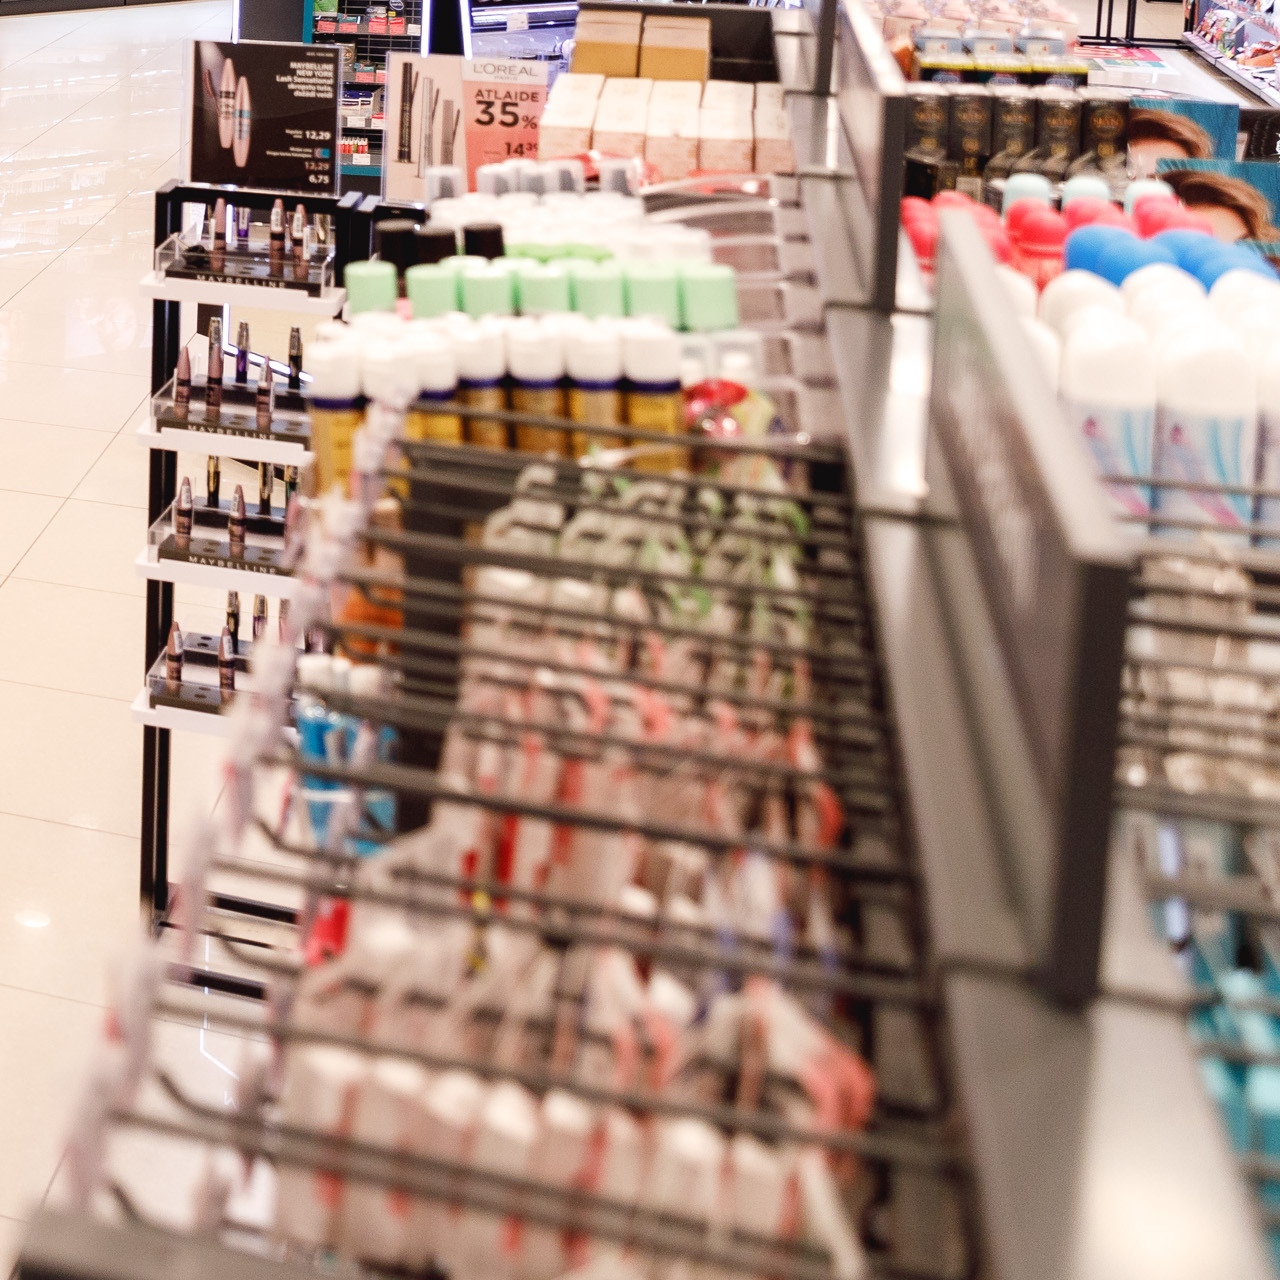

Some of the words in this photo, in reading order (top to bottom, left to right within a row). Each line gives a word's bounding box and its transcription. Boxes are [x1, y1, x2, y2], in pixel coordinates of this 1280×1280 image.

[290, 62, 334, 71] MAYBELLINE
[314, 70, 333, 78] YORK
[474, 89, 540, 102] ATLAIDE
[305, 130, 331, 140] 12,29
[308, 175, 330, 184] 6,75
[196, 274, 286, 289] MAYBELLINE
[188, 424, 276, 440] MAYBELLINE
[188, 555, 276, 573] MAYBELLINE
